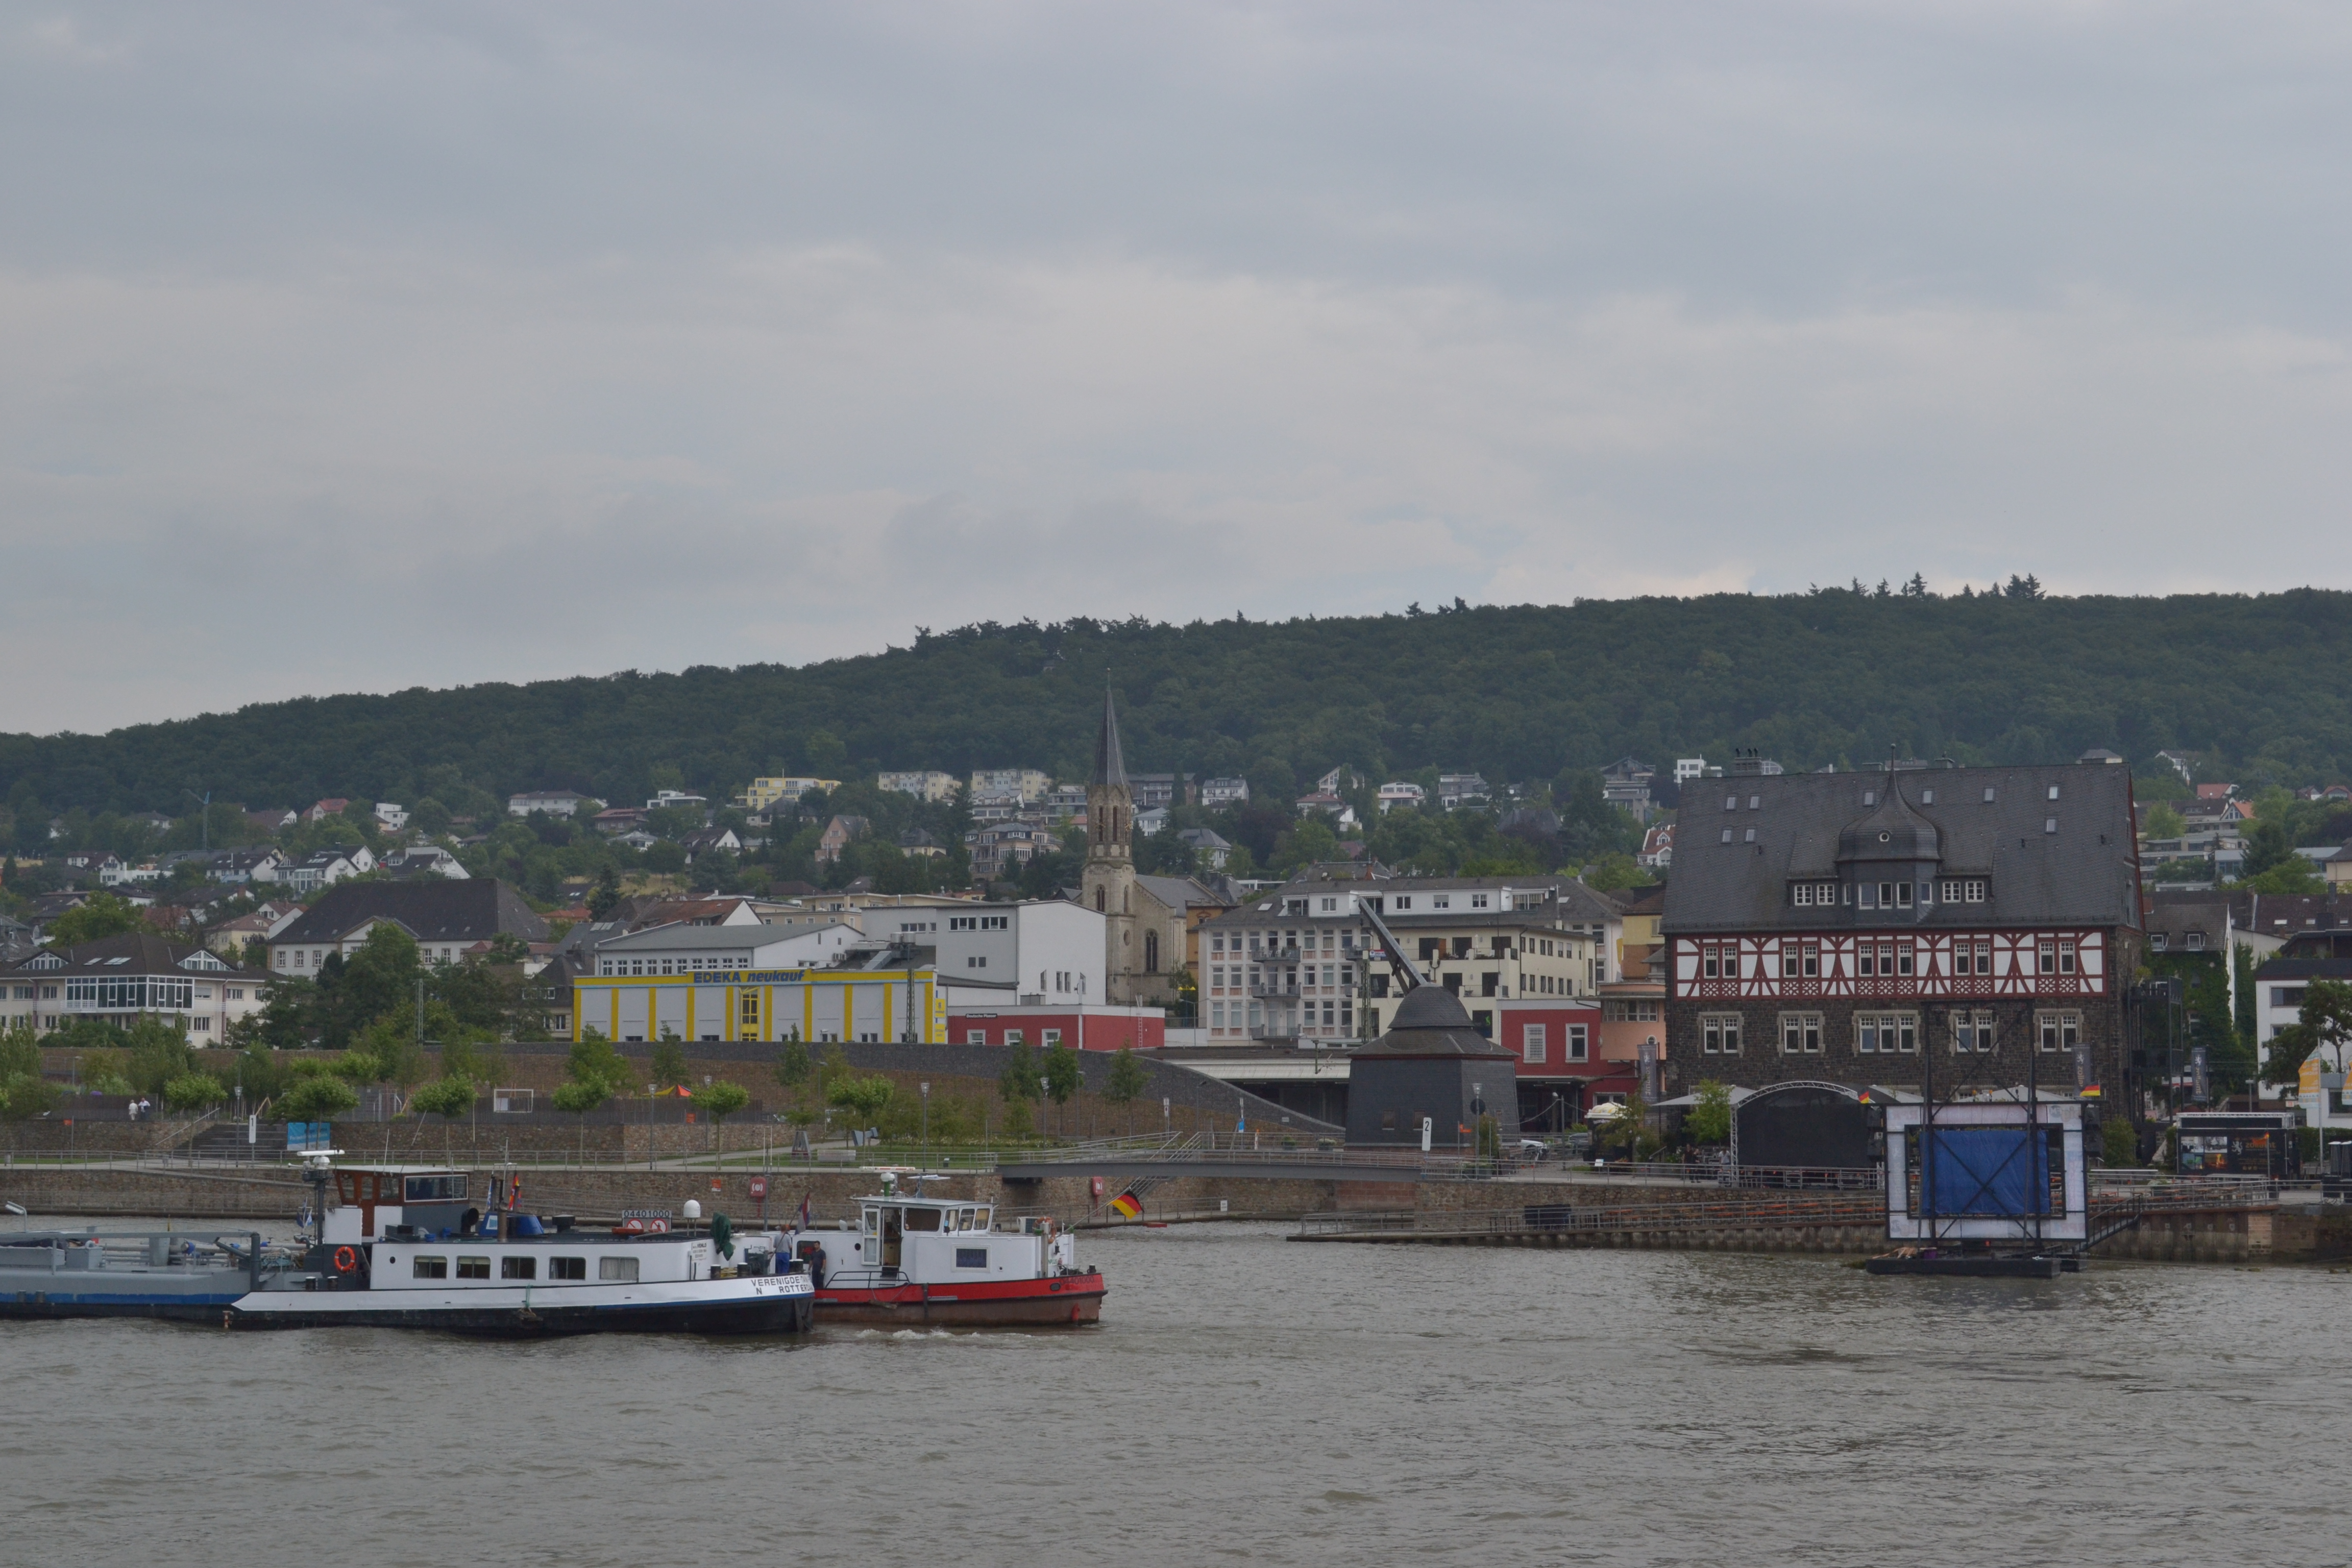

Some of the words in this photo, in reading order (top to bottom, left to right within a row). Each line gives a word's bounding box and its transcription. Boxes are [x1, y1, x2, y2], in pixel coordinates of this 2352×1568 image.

[693, 971, 741, 983] EDEKA
[747, 969, 805, 983] neukauf
[251, 1118, 254, 1126] 1
[1425, 1121, 1429, 1131] 2
[751, 1276, 800, 1287] VERENIGDE
[778, 1284, 814, 1294] ROTTER
